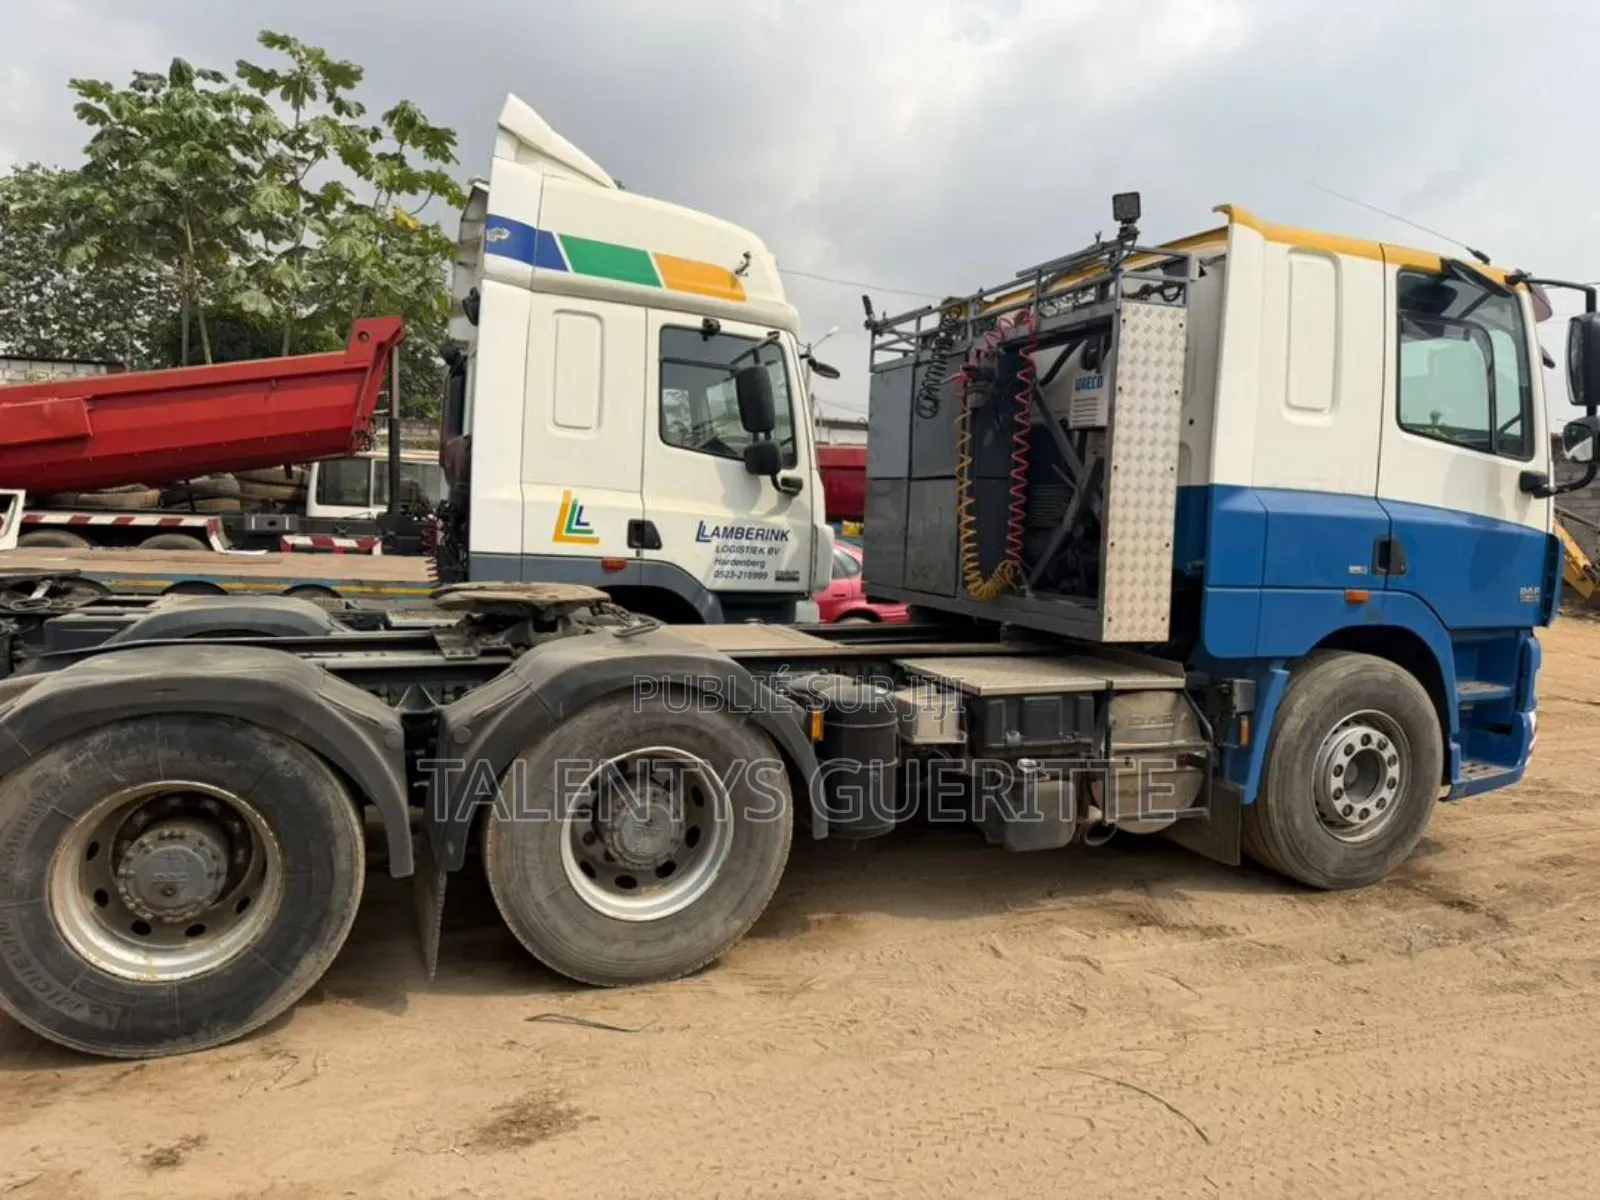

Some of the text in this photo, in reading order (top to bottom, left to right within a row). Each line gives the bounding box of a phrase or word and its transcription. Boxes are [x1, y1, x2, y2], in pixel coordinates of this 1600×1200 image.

[715, 545, 781, 556] LOGISTIEK BV
[713, 557, 766, 569] Hardenberg
